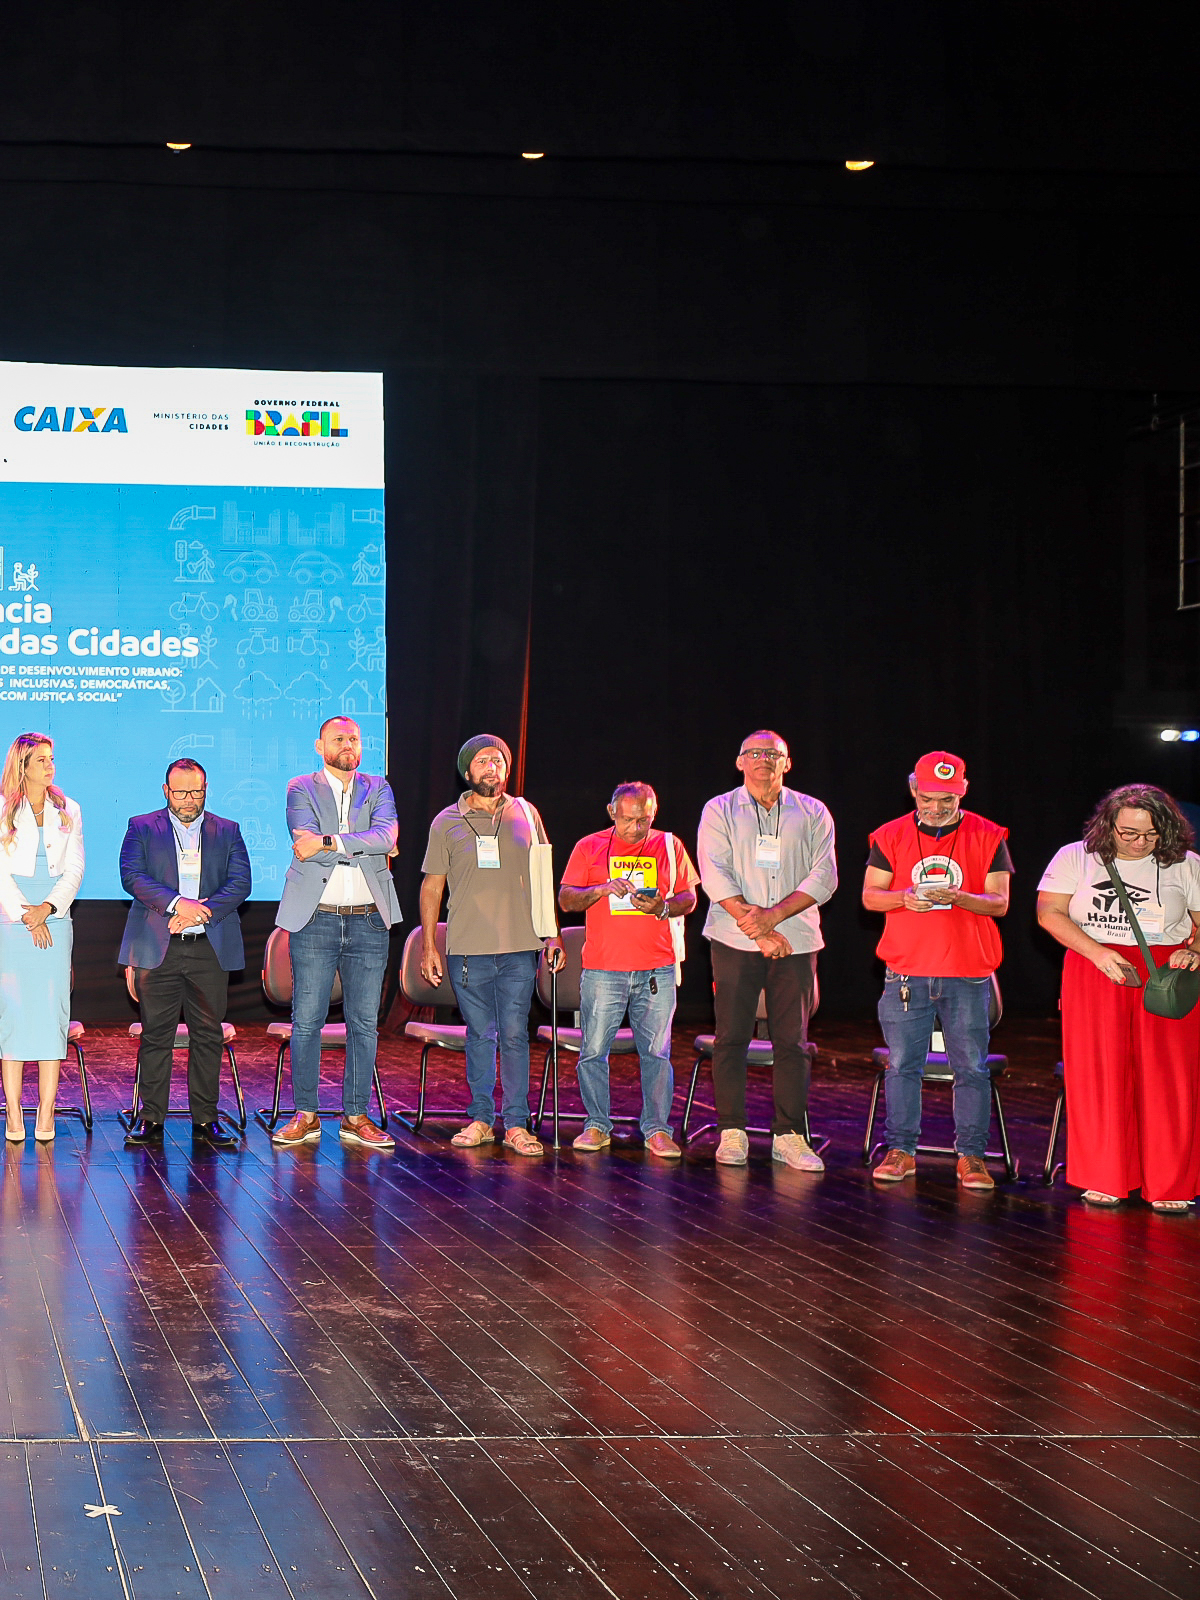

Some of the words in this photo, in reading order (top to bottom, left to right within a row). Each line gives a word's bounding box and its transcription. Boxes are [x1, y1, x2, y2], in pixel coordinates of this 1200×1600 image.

[14, 405, 129, 433] CAIXA
[153, 411, 208, 420] MINISTÉRIO
[245, 409, 349, 438] BRASIL
[0, 627, 58, 656] das
[67, 627, 200, 657] Cidades
[0, 665, 15, 675] DE
[18, 665, 130, 677] DESENVOLVIMENTO
[132, 666, 183, 677] URBANO:
[9, 678, 78, 690] INCLUSIVAS,
[80, 677, 171, 691] DEMOCRÁTICAS,
[0, 691, 28, 701] COM
[29, 691, 74, 703] JUSTIÇA
[613, 859, 652, 869] UNIÃO
